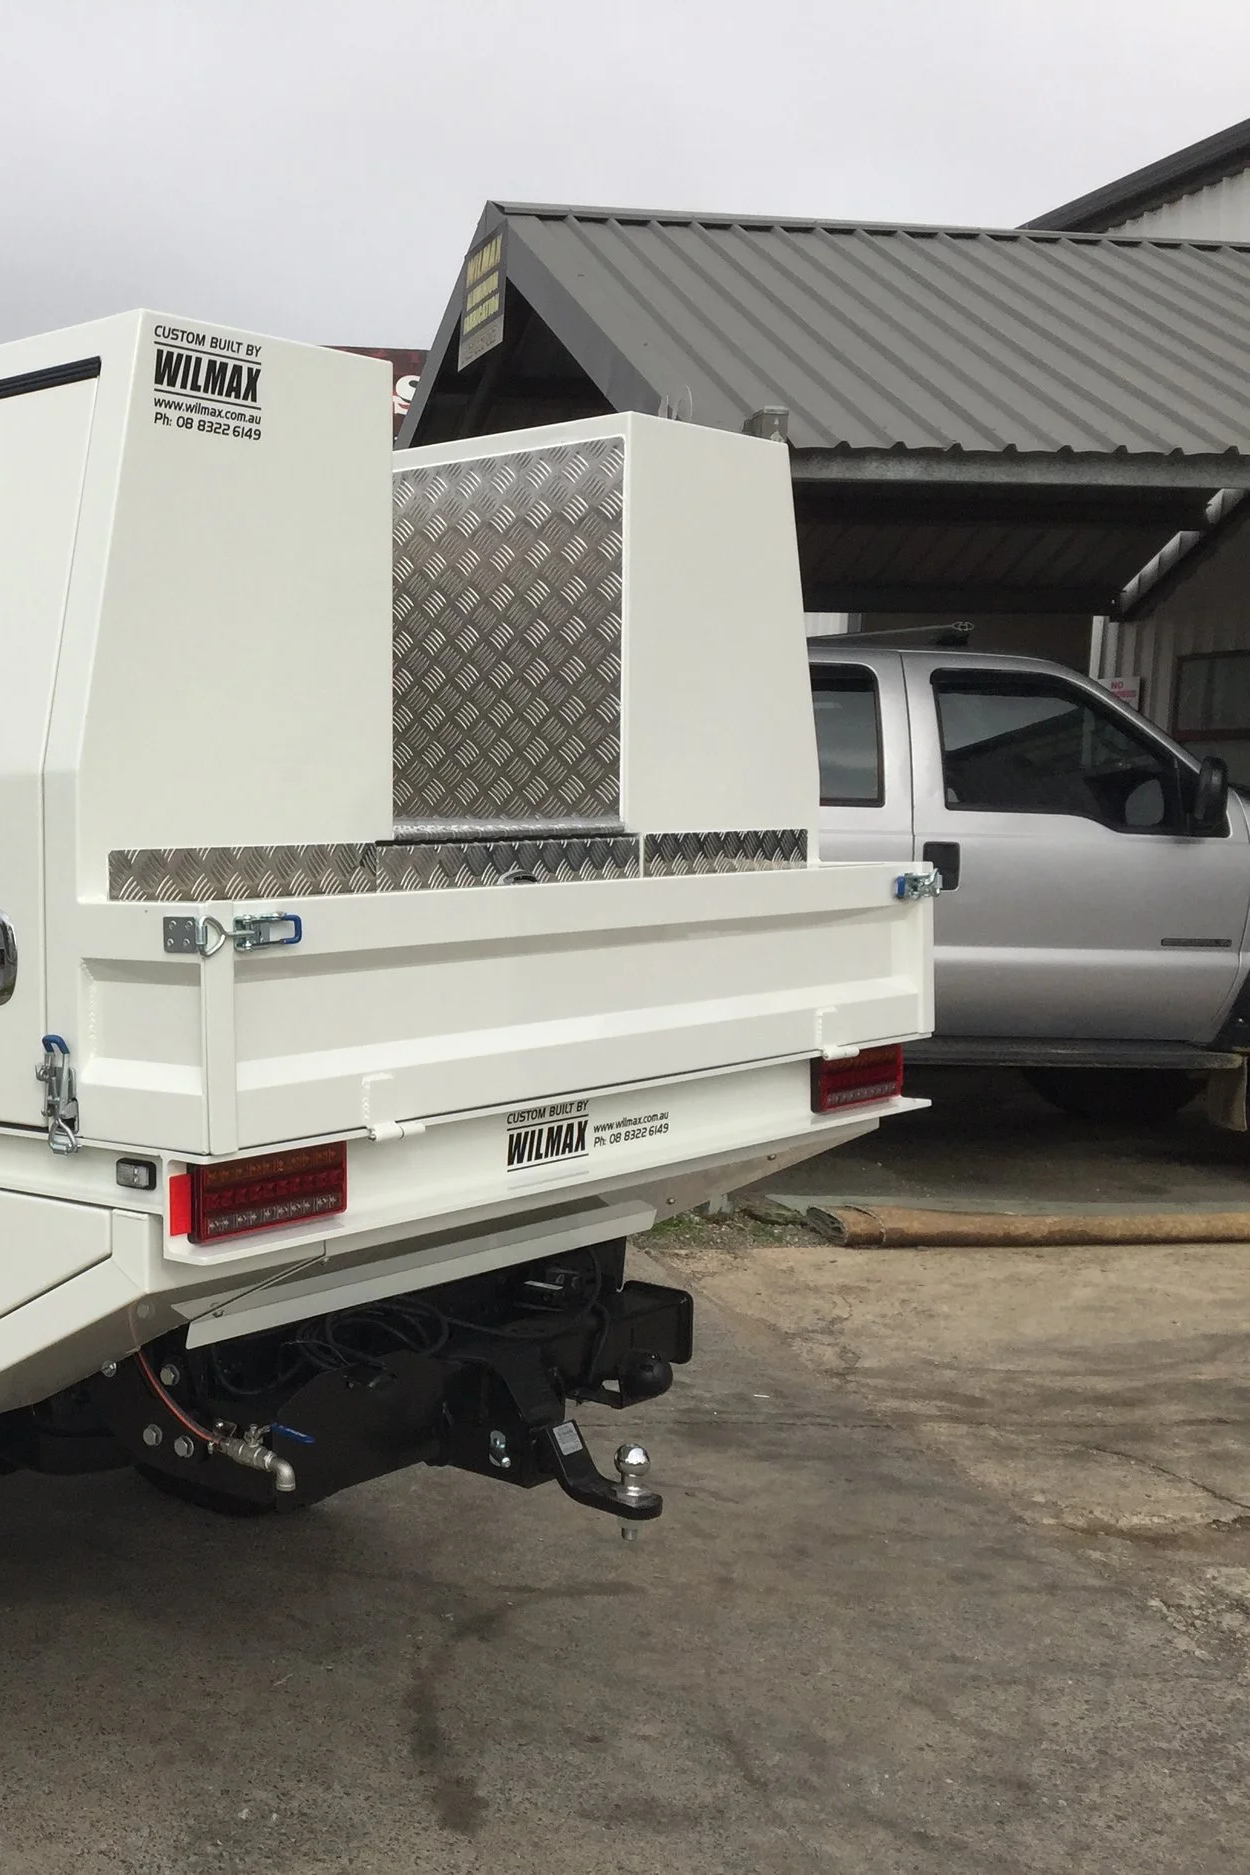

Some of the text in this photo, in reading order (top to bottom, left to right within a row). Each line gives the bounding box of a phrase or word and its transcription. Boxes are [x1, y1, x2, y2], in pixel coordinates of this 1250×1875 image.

[154, 325, 262, 358] CUSTOM BUILT BY
[154, 348, 261, 403] WILMAX
[154, 397, 261, 425] www.wilmax.com.au
[154, 412, 261, 441] Ph: 08 8322 6149
[507, 1100, 589, 1125] CUSTOM BUILT BY
[593, 1111, 669, 1133] www.wilmax.com.au
[507, 1120, 588, 1166] WILMAX
[609, 1133, 621, 1145] 08
[624, 1127, 647, 1142] 8322
[648, 1123, 669, 1137] 6149
